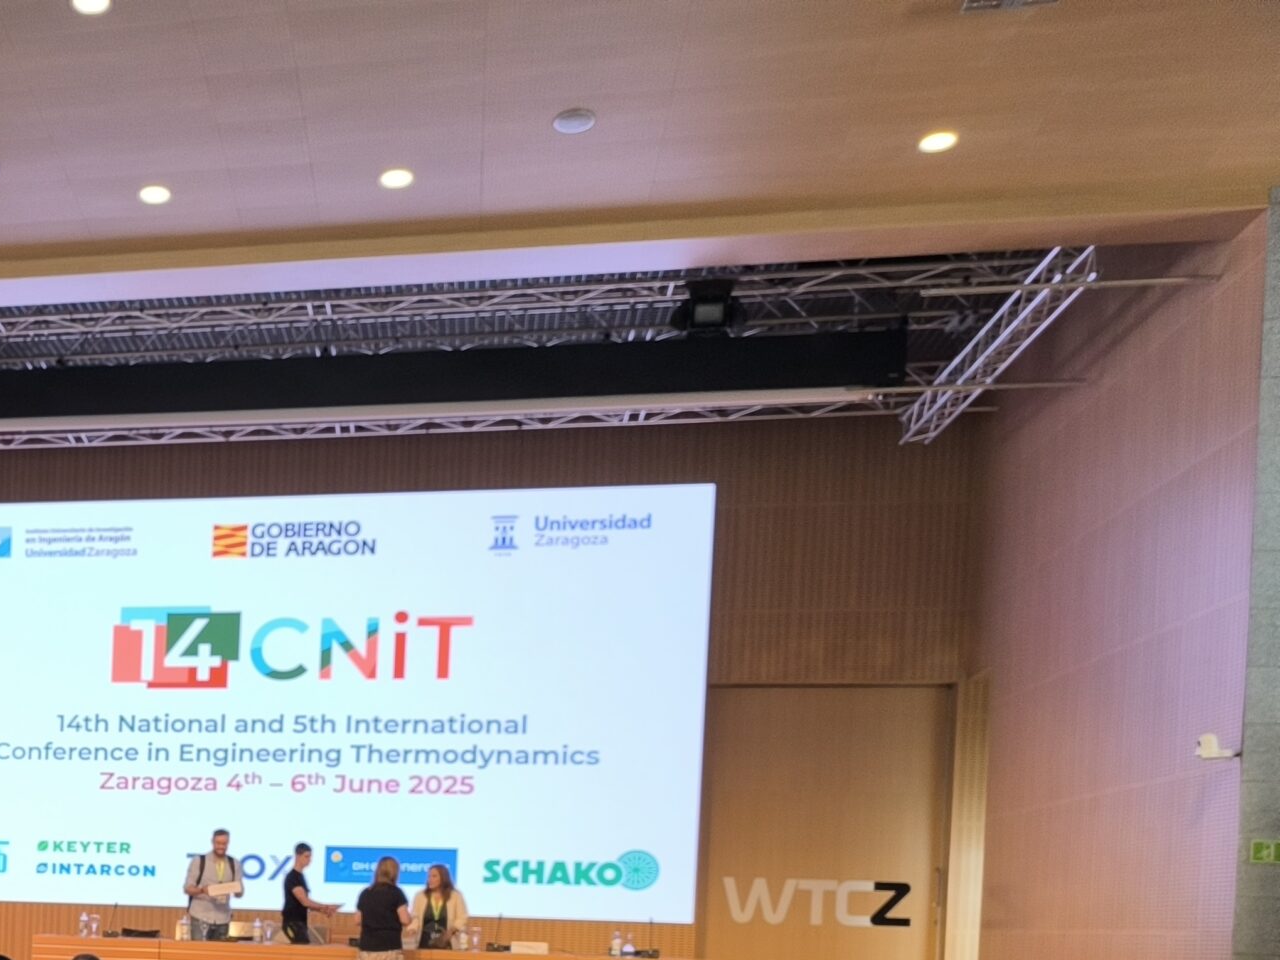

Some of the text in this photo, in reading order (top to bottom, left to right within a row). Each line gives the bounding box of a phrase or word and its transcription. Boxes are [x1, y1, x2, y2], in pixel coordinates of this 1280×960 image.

[251, 520, 361, 539] GOBIERNO
[534, 513, 652, 531] Universidad
[85, 534, 95, 543] de
[251, 539, 376, 557] DE ARAGON
[534, 533, 609, 549] Zaragoza
[129, 617, 222, 682] 14
[57, 713, 528, 735] 14th National and 5th International
[147, 742, 170, 762] in
[179, 742, 342, 768] Engineering
[351, 744, 600, 769] Thermodynamics
[99, 772, 217, 795] Zaragoza
[226, 771, 262, 791] 4th
[291, 772, 325, 793] 6th
[333, 774, 400, 793] June
[409, 775, 475, 795] 2025
[53, 841, 131, 854] KEYTER
[52, 863, 156, 877] INTARCON
[483, 860, 621, 887] SCHAKO
[723, 876, 912, 928] WTCZ
